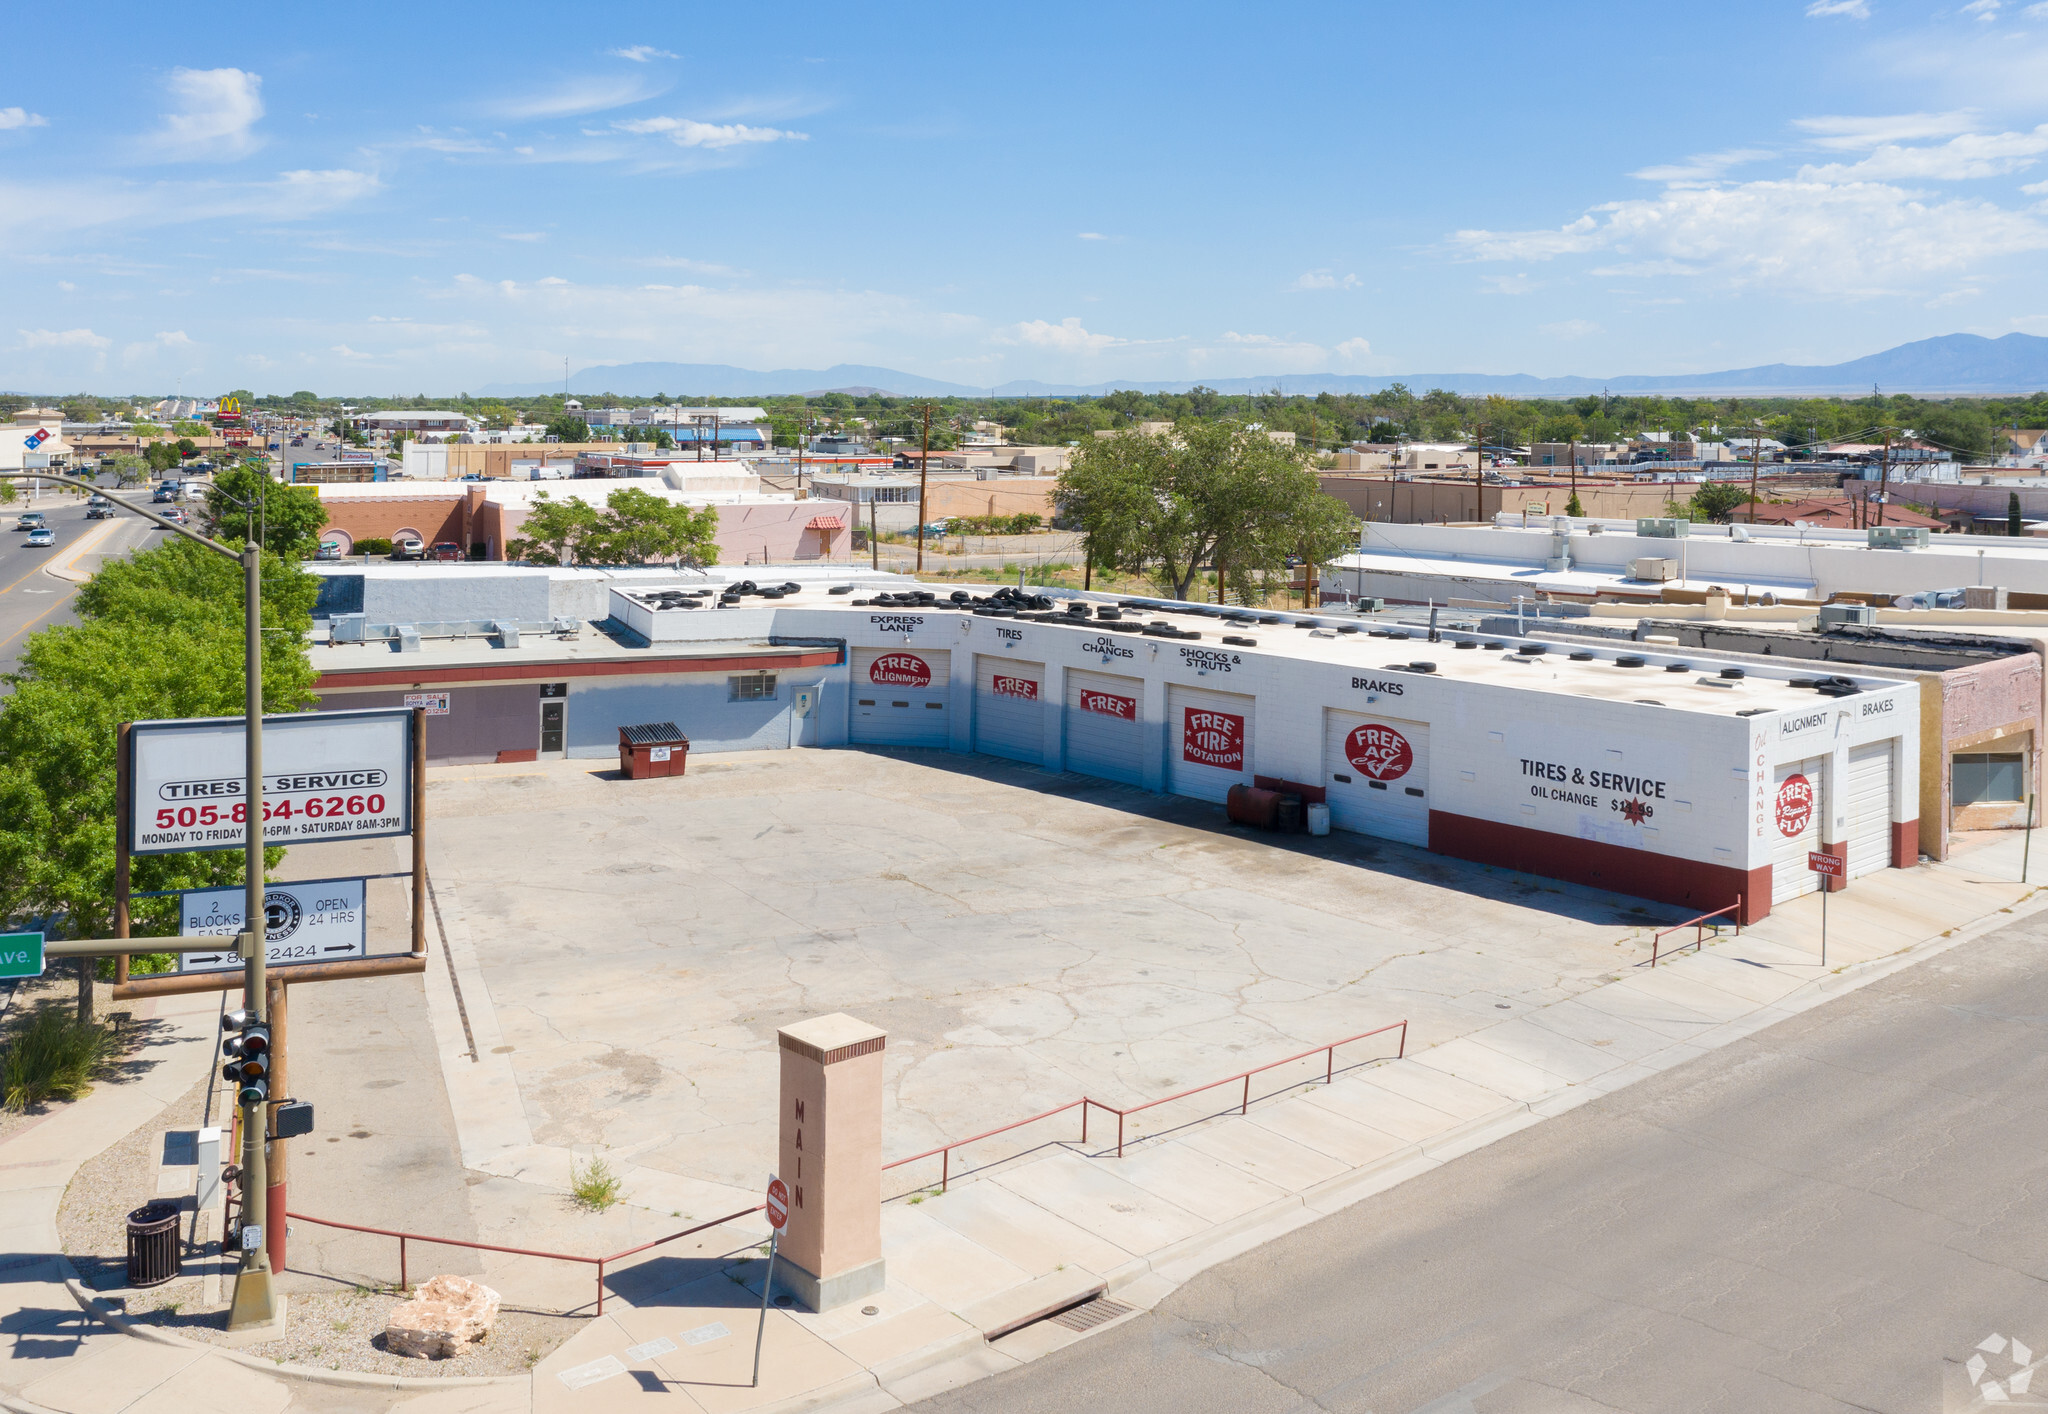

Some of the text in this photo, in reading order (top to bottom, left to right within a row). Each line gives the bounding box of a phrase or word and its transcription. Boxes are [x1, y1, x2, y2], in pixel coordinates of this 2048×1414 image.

[870, 616, 924, 624] EXPRESS
[880, 624, 914, 632] LANE
[996, 628, 1022, 640] TIRES
[1097, 637, 1115, 647] OIL
[1082, 643, 1134, 658] CHANGES
[1180, 648, 1242, 664] SHOCKS &
[877, 656, 922, 672] FREE
[1186, 658, 1232, 672] STRUTS
[872, 670, 930, 684] ALIGNMENT
[998, 678, 1034, 697] FREE
[1352, 677, 1404, 696] BRAKES
[1088, 696, 1127, 716] FREE
[1862, 698, 1894, 716] BRAKES
[1190, 713, 1236, 736] FREE
[1782, 712, 1828, 735] ALIGNMENT
[1196, 731, 1230, 752] TIRE
[1355, 729, 1405, 753] FREE
[1185, 742, 1242, 764] ROTATION
[1364, 746, 1394, 760] AC
[166, 782, 240, 797] TIRES
[276, 772, 380, 790] SERVICE
[1520, 758, 1666, 799] TIRES & SERVICE
[1530, 785, 1548, 798] OIL
[1551, 789, 1598, 808] CHANGE
[1756, 754, 1766, 837] CHANGE
[1778, 782, 1810, 807] FREE
[142, 832, 186, 844] MONDAY
[190, 831, 204, 842] TO
[206, 828, 242, 840] FRIDAY
[302, 820, 354, 834] SATURDAY
[356, 817, 400, 830] 8AM-3PM
[1780, 813, 1808, 832] FLAT
[1810, 854, 1840, 866] WRONG
[1816, 864, 1834, 873] WAY
[212, 902, 218, 912] 2
[316, 898, 348, 912] OPEN
[190, 914, 240, 928] BLOCKS
[309, 911, 354, 926] 24 HRS
[795, 1098, 804, 1209] MAIN
[778, 1191, 786, 1202] NOT
[770, 1206, 782, 1222] ENTER
